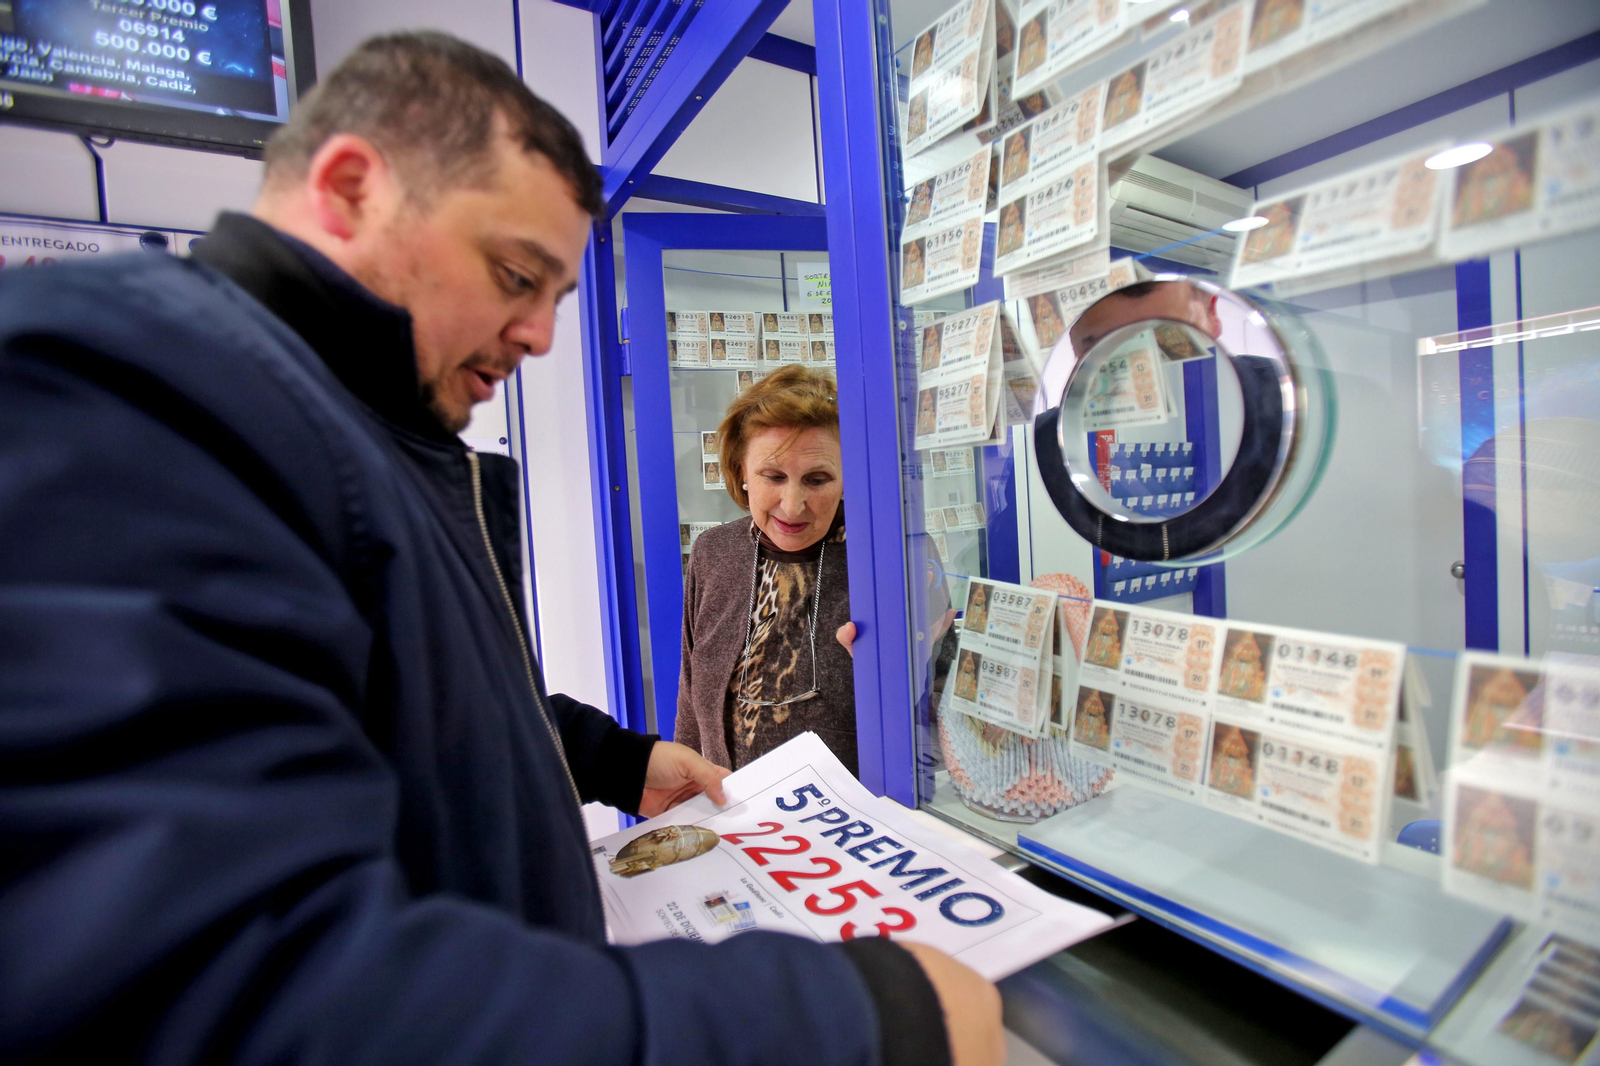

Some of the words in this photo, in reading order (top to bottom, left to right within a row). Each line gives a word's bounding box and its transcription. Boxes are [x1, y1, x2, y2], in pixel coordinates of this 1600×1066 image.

[119, 19, 185, 43] 06914
[150, 11, 209, 32] Premio
[95, 31, 191, 61] 500.000
[197, 51, 212, 65] €
[49, 59, 142, 86] Cantabria,
[145, 75, 197, 95] Cadiz,
[125, 59, 191, 81] Malaga,
[937, 162, 972, 186] 61156
[1029, 177, 1074, 207] 19476
[1, 235, 100, 253] ENTREGADO
[926, 228, 963, 249] 61156
[804, 273, 831, 281] SORTE
[1060, 278, 1108, 304] 80454
[944, 315, 979, 335] 95277
[939, 382, 970, 400] 95277
[993, 591, 1032, 607] 03587
[1132, 620, 1189, 641] 13078
[1278, 643, 1358, 669] 01148
[981, 660, 1018, 679] 03587
[1119, 703, 1176, 729] 13078
[1263, 741, 1339, 775] 01148
[775, 783, 832, 812] 5º
[798, 805, 1005, 928] PREMIO
[719, 821, 918, 943] 22253
[655, 909, 673, 930] SORTEO
[667, 901, 678, 912] 22
[673, 911, 685, 921] DE
[680, 920, 704, 943] DICIEM
